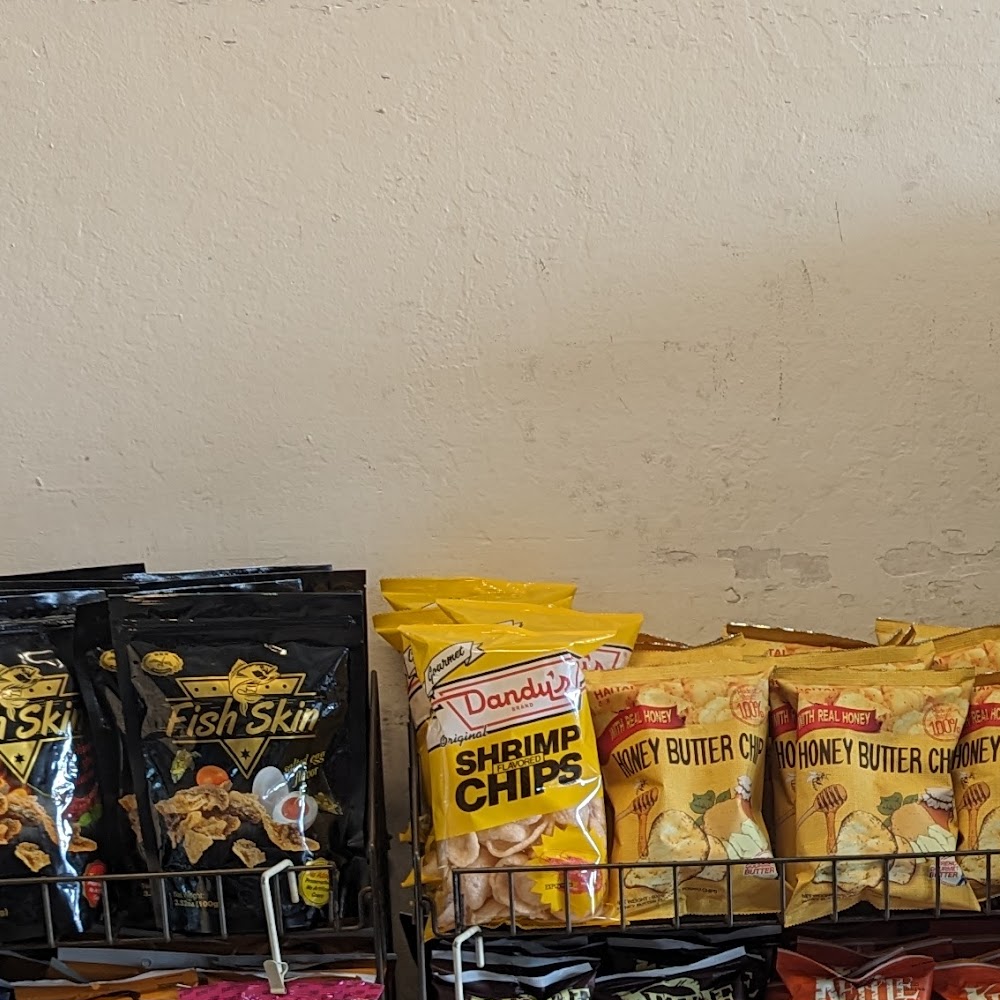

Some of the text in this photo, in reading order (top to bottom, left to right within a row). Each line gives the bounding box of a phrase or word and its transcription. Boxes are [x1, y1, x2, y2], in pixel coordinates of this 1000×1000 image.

[428, 645, 465, 681] Gourmet
[464, 672, 572, 717] Dandy's
[166, 700, 321, 737] Fish Skin
[626, 712, 643, 726] REAL
[817, 708, 840, 722] REAL
[456, 724, 581, 777] SHRIMP
[496, 754, 543, 773] FLAVORED
[666, 734, 734, 766] BUTTER
[799, 738, 853, 770] HONEY
[858, 741, 922, 774] BUTTER
[455, 752, 583, 813] CHIPS
